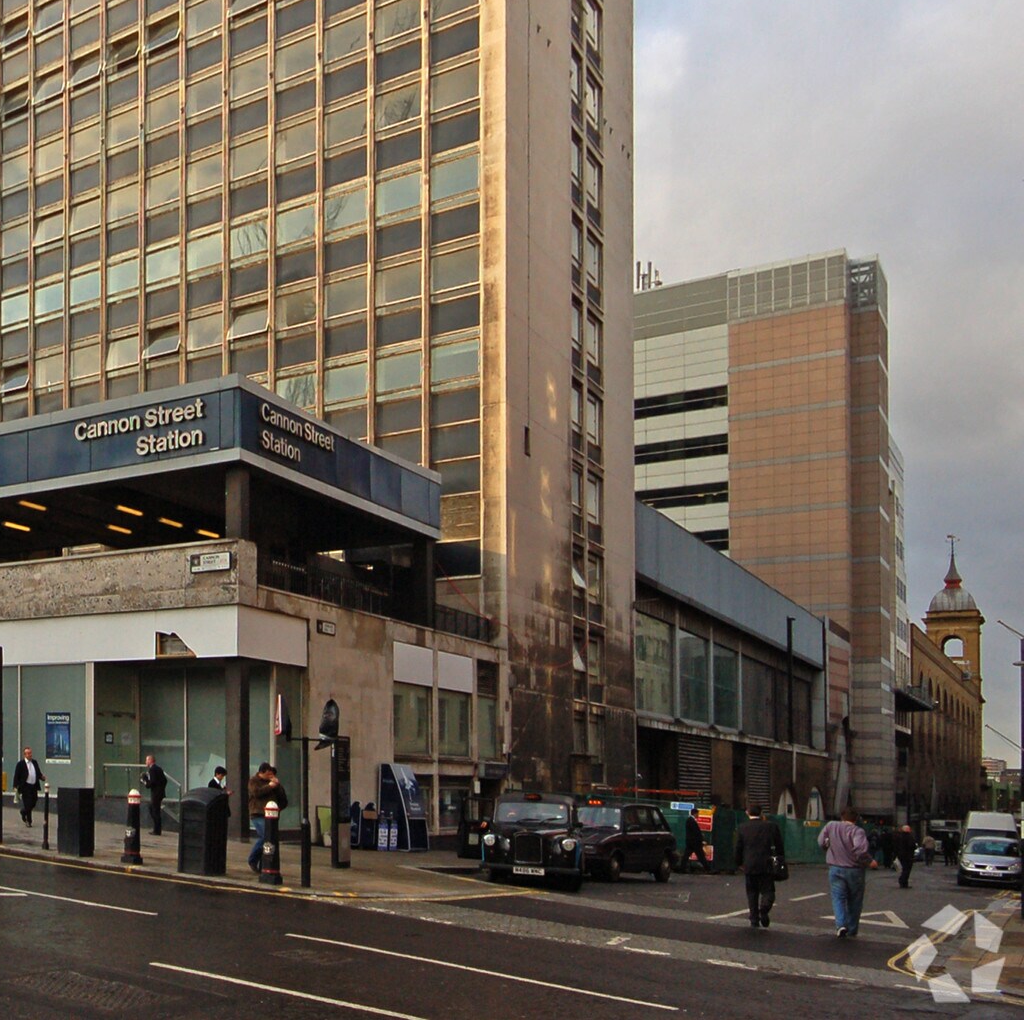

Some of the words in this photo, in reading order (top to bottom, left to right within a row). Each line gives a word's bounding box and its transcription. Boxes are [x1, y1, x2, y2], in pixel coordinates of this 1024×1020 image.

[74, 414, 141, 441] Cannon
[144, 398, 204, 428] Street
[261, 402, 303, 438] Cannon
[304, 422, 335, 453] Street
[136, 428, 204, 456] Station
[261, 429, 301, 462] Station
